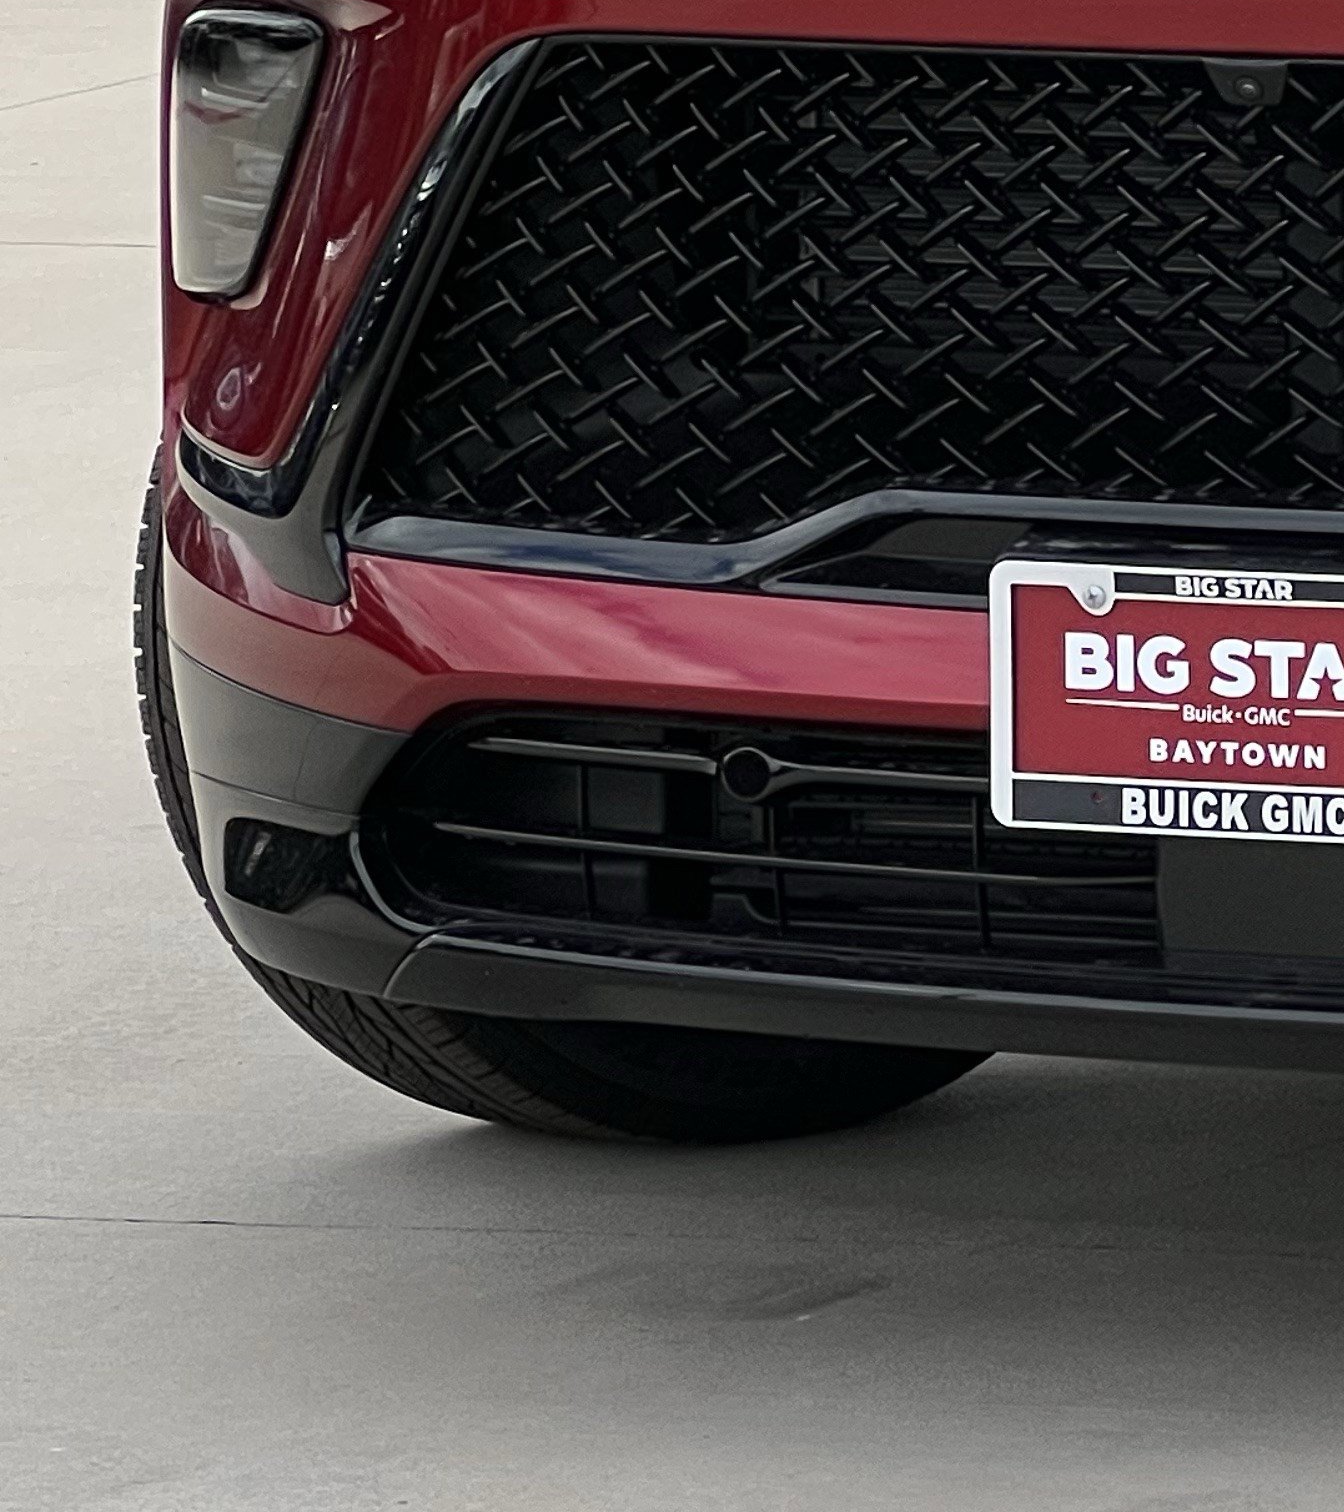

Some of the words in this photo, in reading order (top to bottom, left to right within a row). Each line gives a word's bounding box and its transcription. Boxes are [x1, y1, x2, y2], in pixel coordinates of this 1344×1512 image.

[1174, 576, 1219, 599] BIG
[1225, 578, 1293, 600] STAR
[1064, 631, 1190, 695] BIG
[1182, 704, 1233, 724] Buick
[1244, 707, 1291, 726] GMC
[1149, 738, 1326, 770] BAYTOWN
[1121, 787, 1249, 831] BUICK
